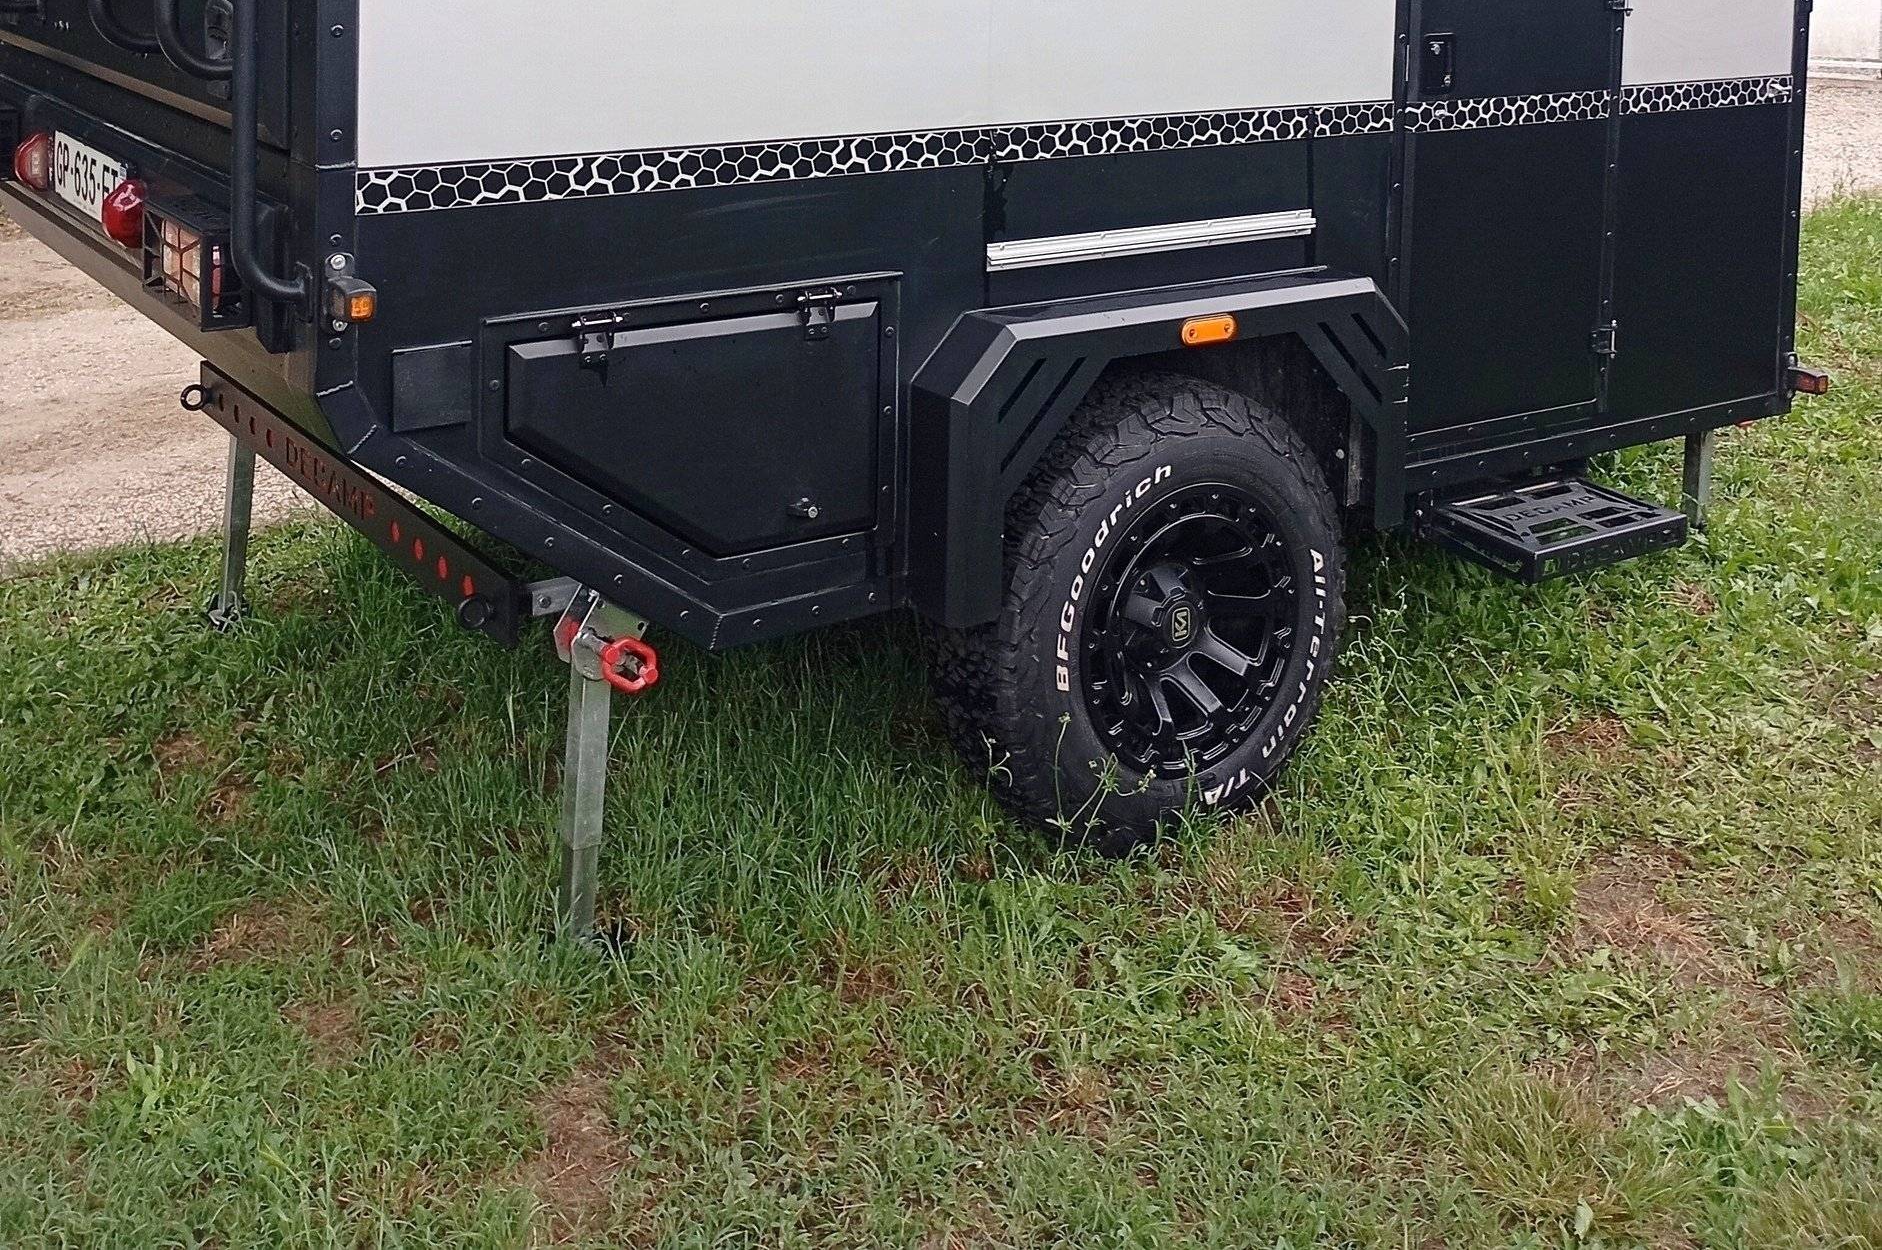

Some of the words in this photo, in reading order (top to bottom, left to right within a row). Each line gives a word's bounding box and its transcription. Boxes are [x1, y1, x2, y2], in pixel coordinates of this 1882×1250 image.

[1502, 495, 1595, 521] DECAMP
[1056, 464, 1171, 692] BFGoodrich
[1261, 549, 1326, 759] All-Terrain
[1204, 767, 1250, 805] T/A
